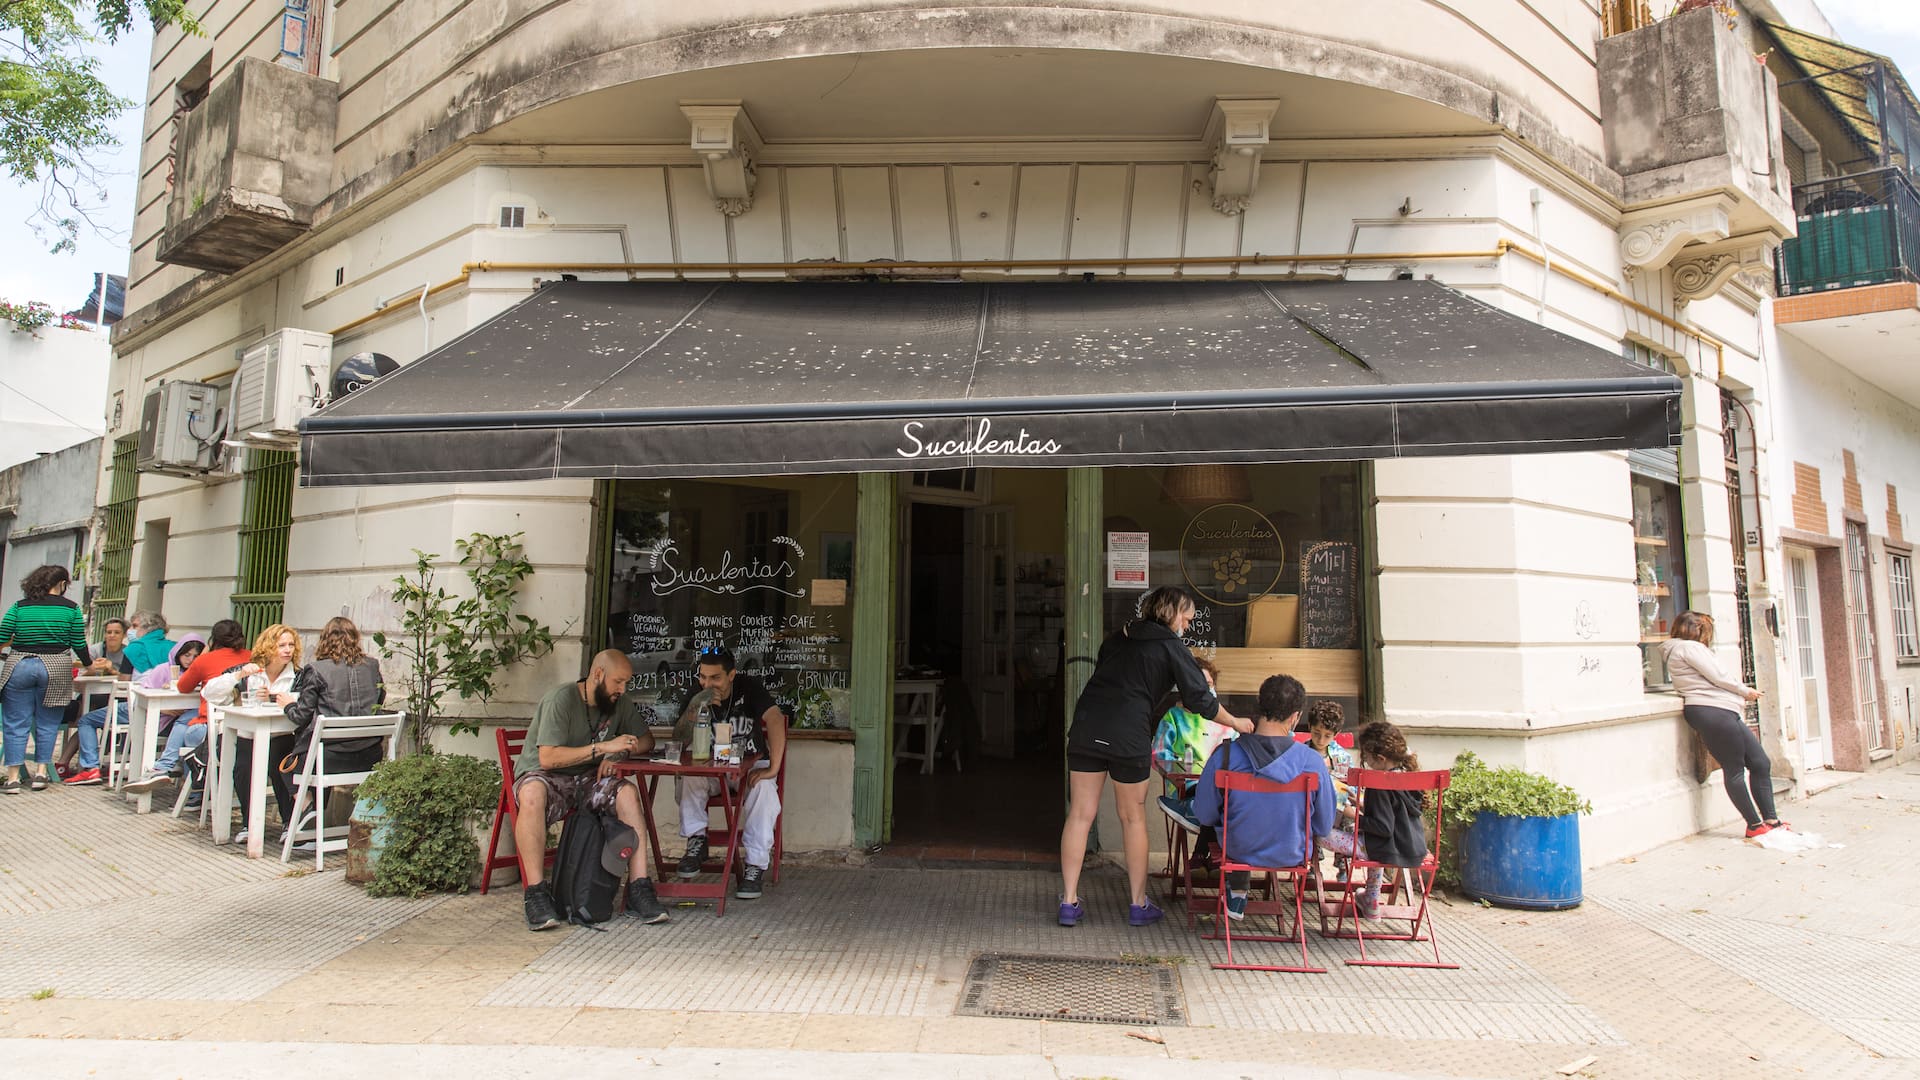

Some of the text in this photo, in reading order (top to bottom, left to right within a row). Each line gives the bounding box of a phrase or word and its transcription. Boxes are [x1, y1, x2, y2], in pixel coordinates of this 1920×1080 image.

[897, 418, 1061, 457] Suculentas
[1193, 520, 1272, 539] Suculentas
[653, 547, 795, 587] Suculentas
[788, 612, 817, 628] CAFÉ
[694, 628, 714, 639] ROLL
[805, 671, 846, 689] BRUNCH
